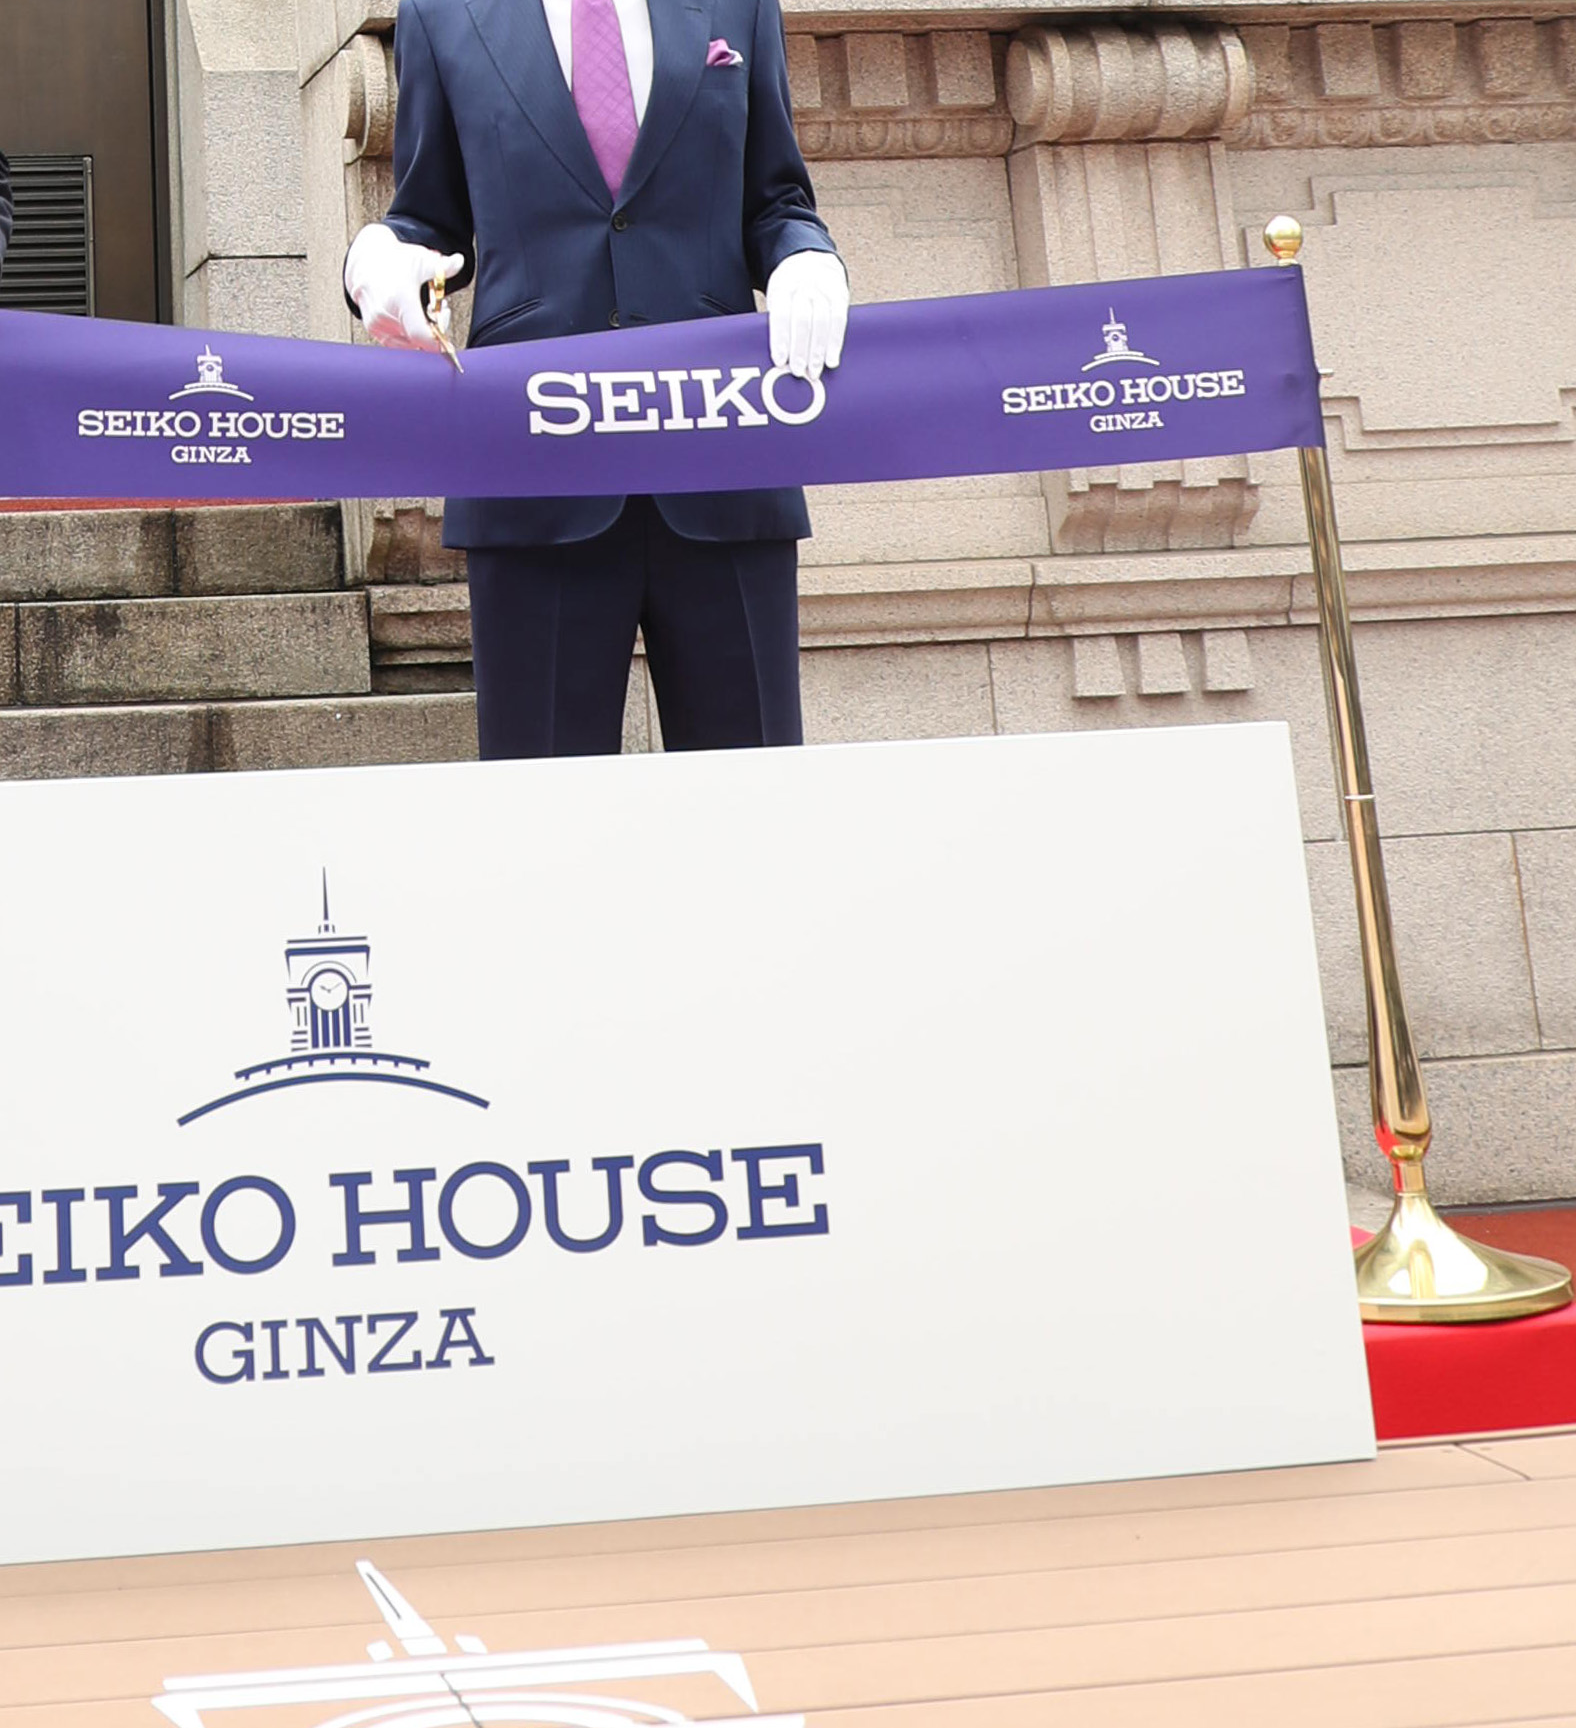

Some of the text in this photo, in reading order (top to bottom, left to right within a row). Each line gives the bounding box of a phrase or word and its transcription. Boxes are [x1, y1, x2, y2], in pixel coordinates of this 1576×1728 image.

[526, 365, 826, 436] SEIKO
[1001, 369, 1247, 414] SEIKO HOUSE
[77, 409, 345, 439] SEIKO HOUSE
[1089, 410, 1165, 433] GINZA
[170, 445, 252, 464] GINZA
[328, 1142, 830, 1267] HOUSE
[194, 1307, 495, 1385] GINZA
